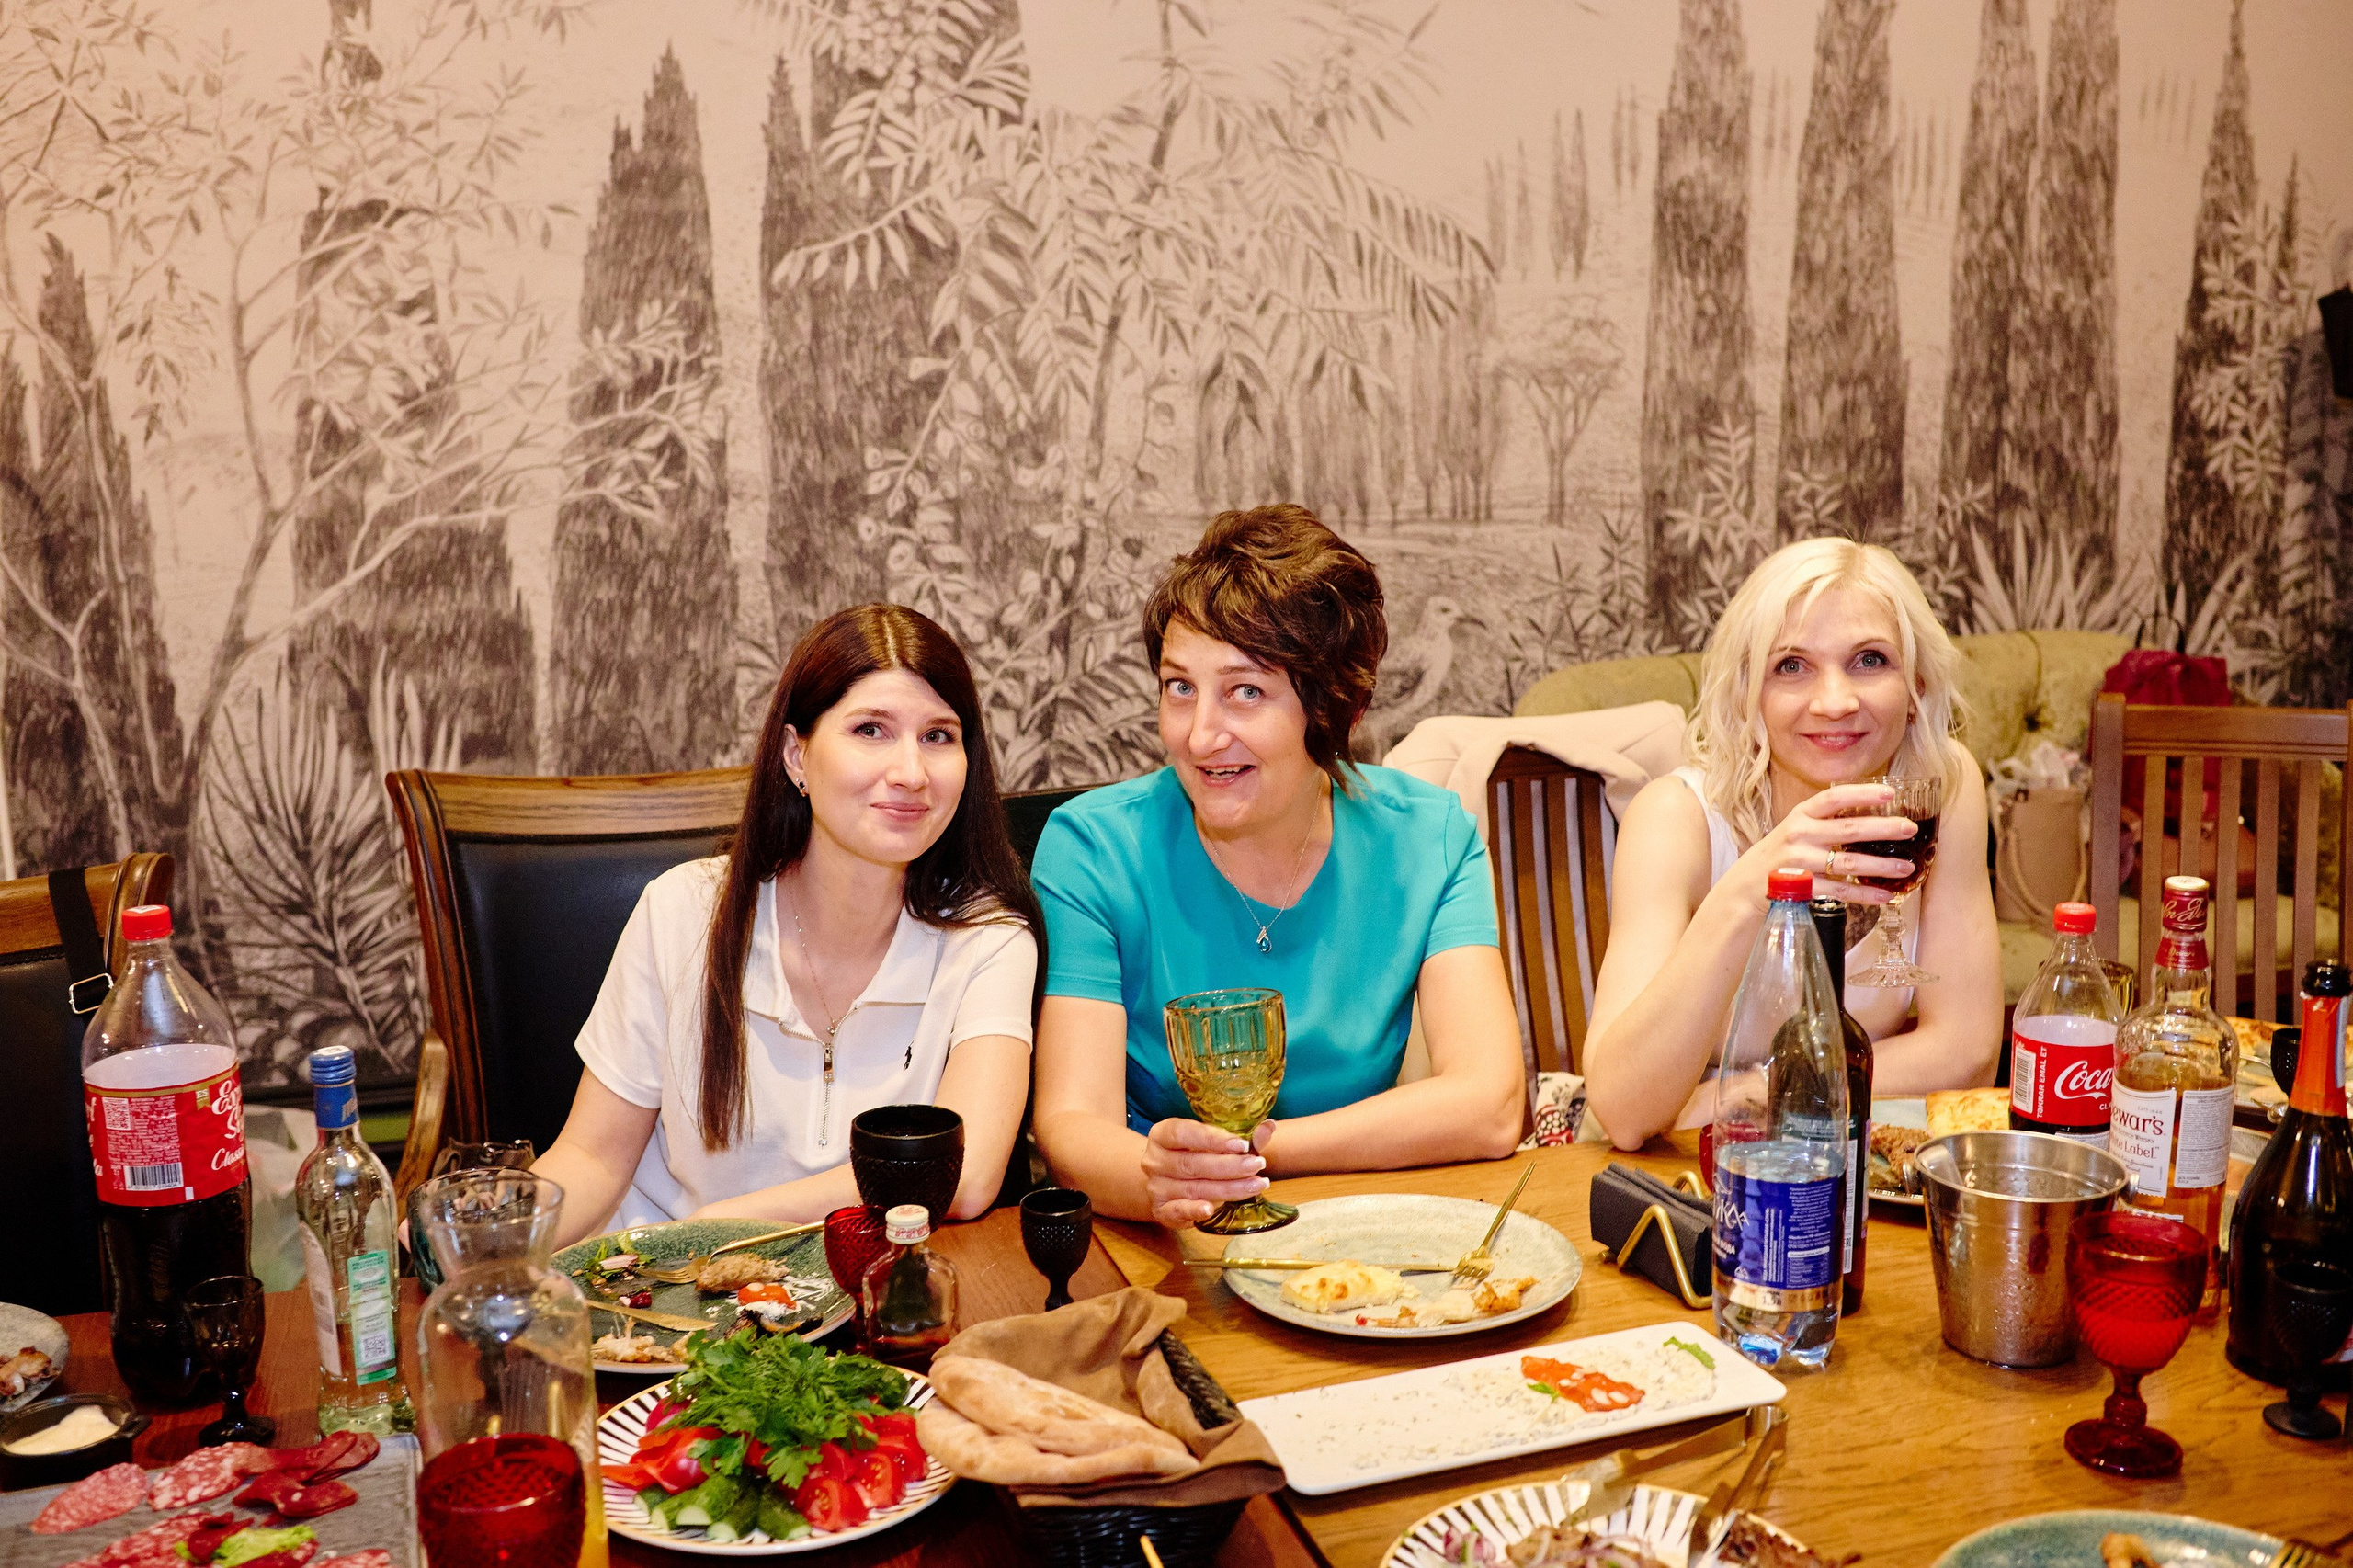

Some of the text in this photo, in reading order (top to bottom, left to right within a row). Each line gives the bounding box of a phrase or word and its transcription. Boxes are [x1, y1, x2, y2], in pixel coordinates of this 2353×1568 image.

[2040, 1045, 2048, 1058] ET
[2039, 1059, 2047, 1084] EMAL
[2054, 1060, 2113, 1100] Coca
[2111, 1105, 2164, 1136] ewar's
[2124, 1141, 2154, 1159] Label
